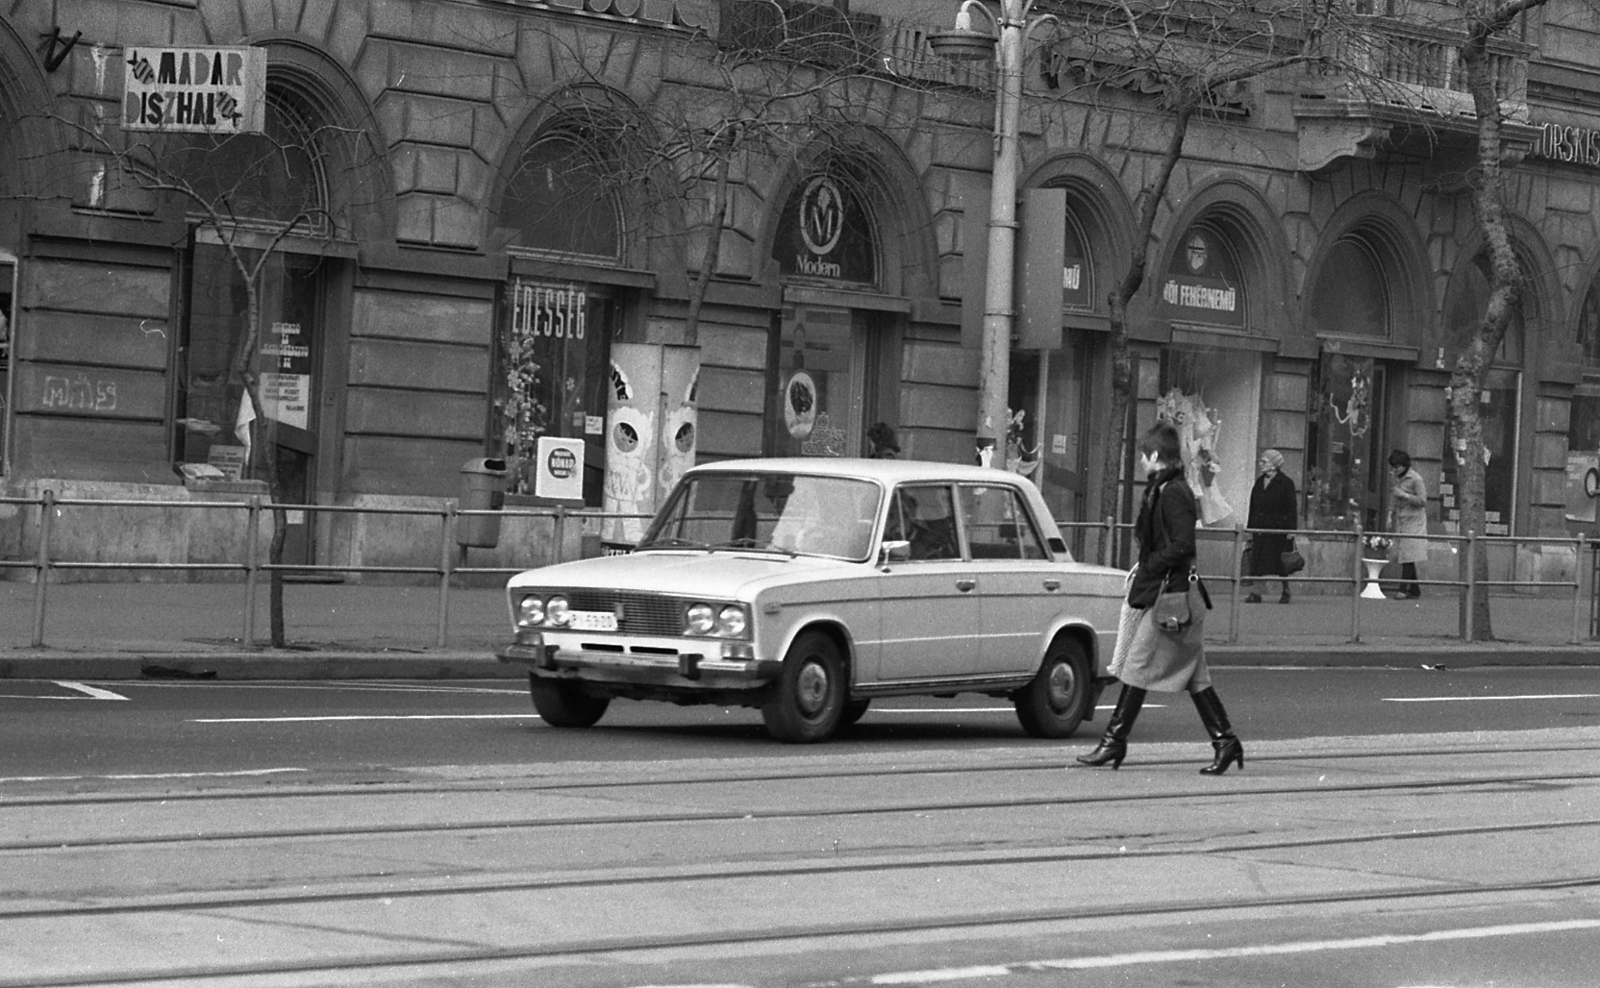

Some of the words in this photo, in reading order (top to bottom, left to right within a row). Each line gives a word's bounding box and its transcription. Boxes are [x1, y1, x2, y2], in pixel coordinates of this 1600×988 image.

[157, 51, 243, 86] MADAR
[125, 91, 217, 125] DISZHAL
[795, 253, 841, 277] Modern
[512, 275, 586, 340] ÉDESSÉG
